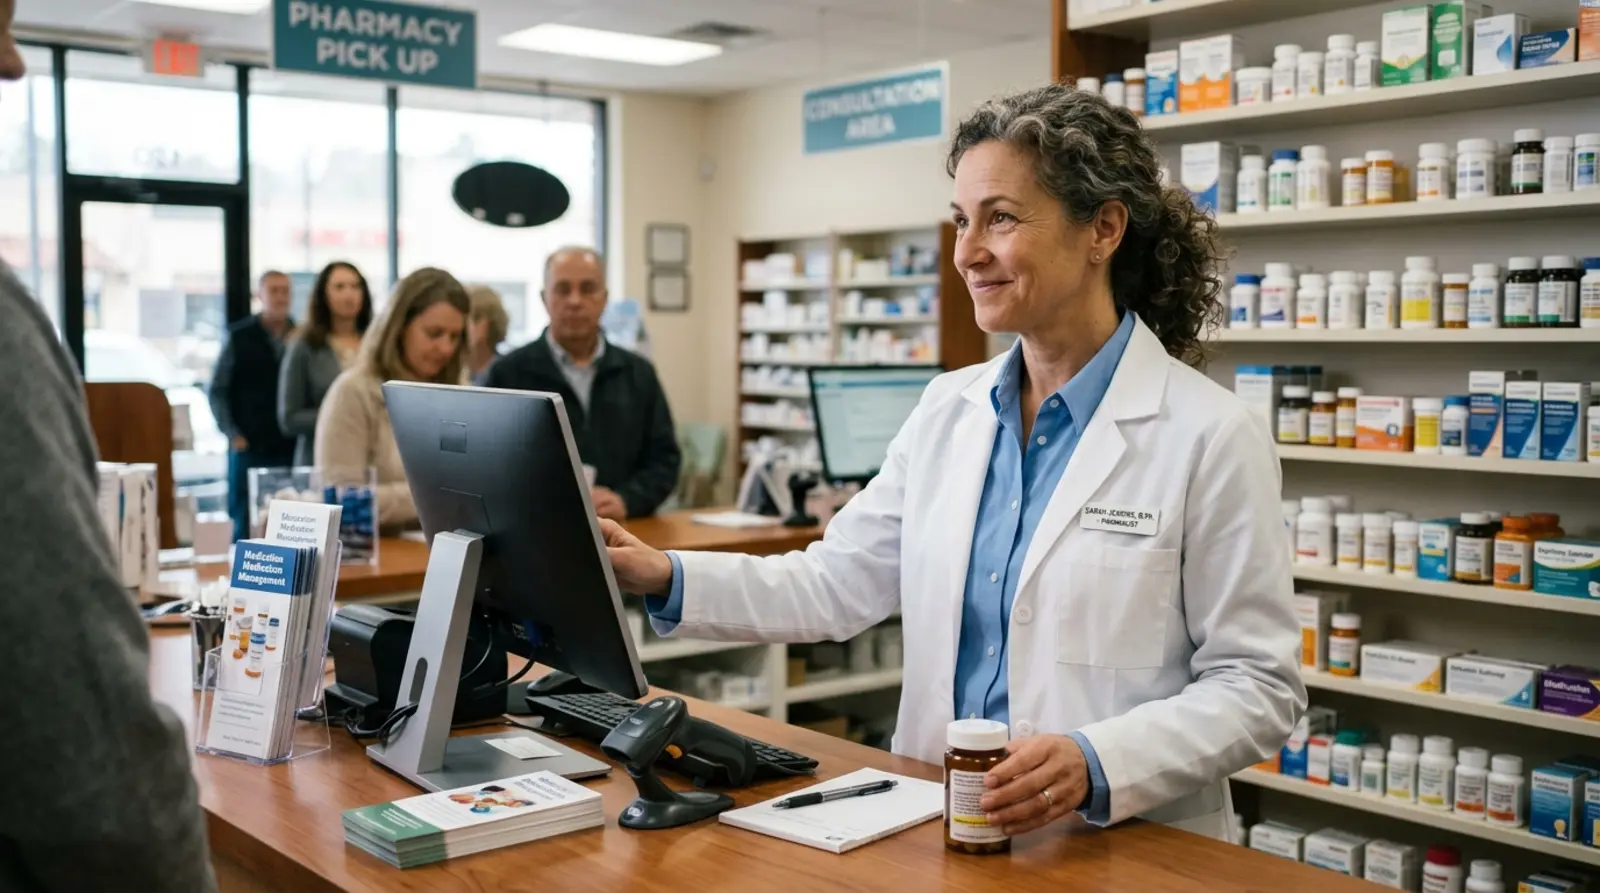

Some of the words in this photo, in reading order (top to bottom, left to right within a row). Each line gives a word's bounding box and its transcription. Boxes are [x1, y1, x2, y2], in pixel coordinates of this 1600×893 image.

[289, 1, 463, 46] PHARMACY
[316, 37, 390, 72] PICK
[396, 46, 439, 75] UP
[803, 79, 940, 121] CONSULTATION
[844, 113, 896, 141] AREA
[237, 572, 286, 586] Management
